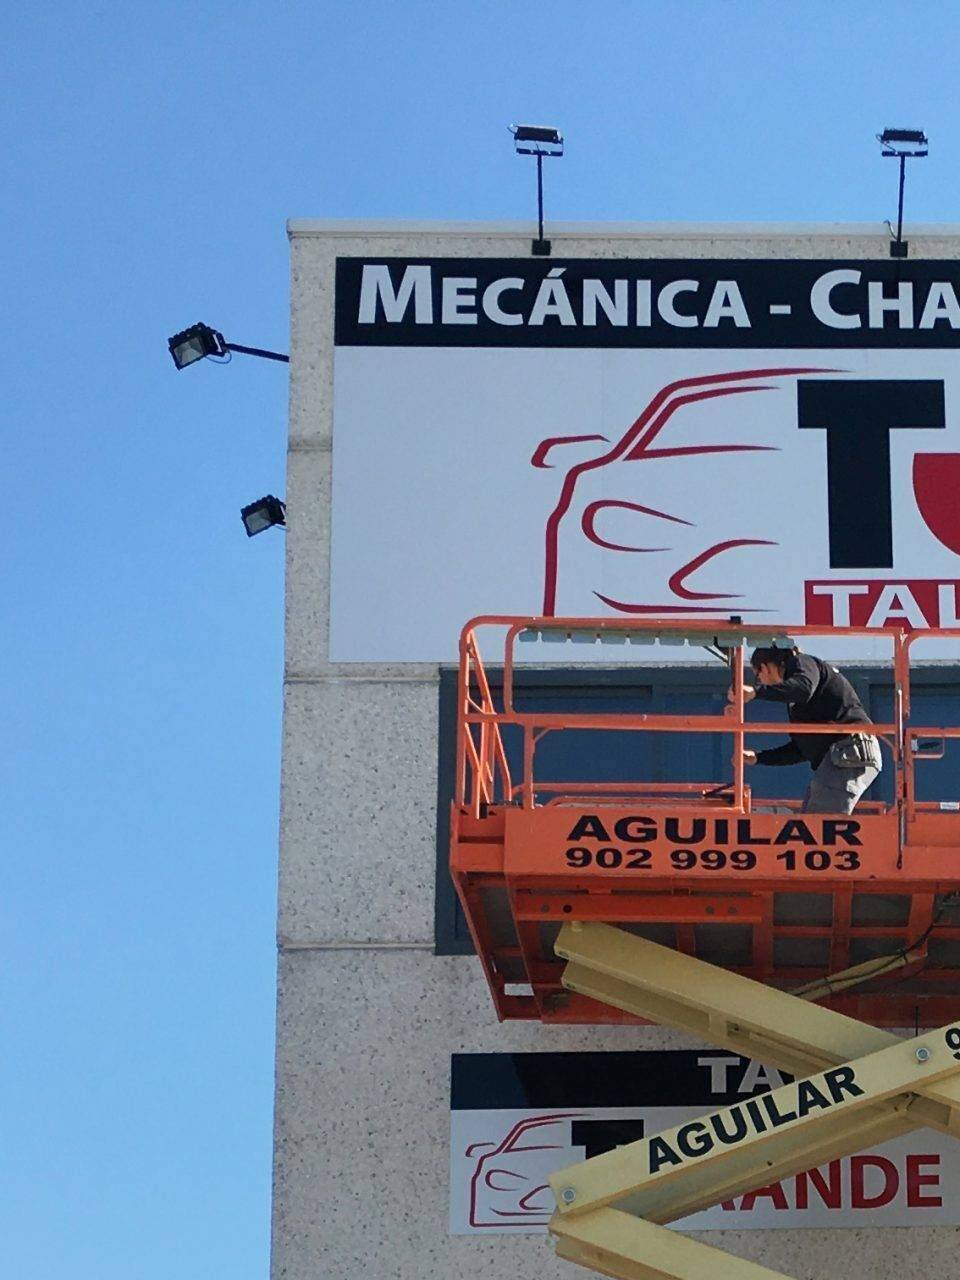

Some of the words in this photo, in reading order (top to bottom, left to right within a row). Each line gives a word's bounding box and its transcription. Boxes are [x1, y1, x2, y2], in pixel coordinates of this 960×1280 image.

[358, 263, 751, 328] MECÁNICA
[567, 815, 863, 846] AGUILAR
[565, 847, 653, 870] 902
[670, 849, 757, 871] 999
[776, 850, 861, 871] 103
[649, 1065, 865, 1175] AGUILAR
